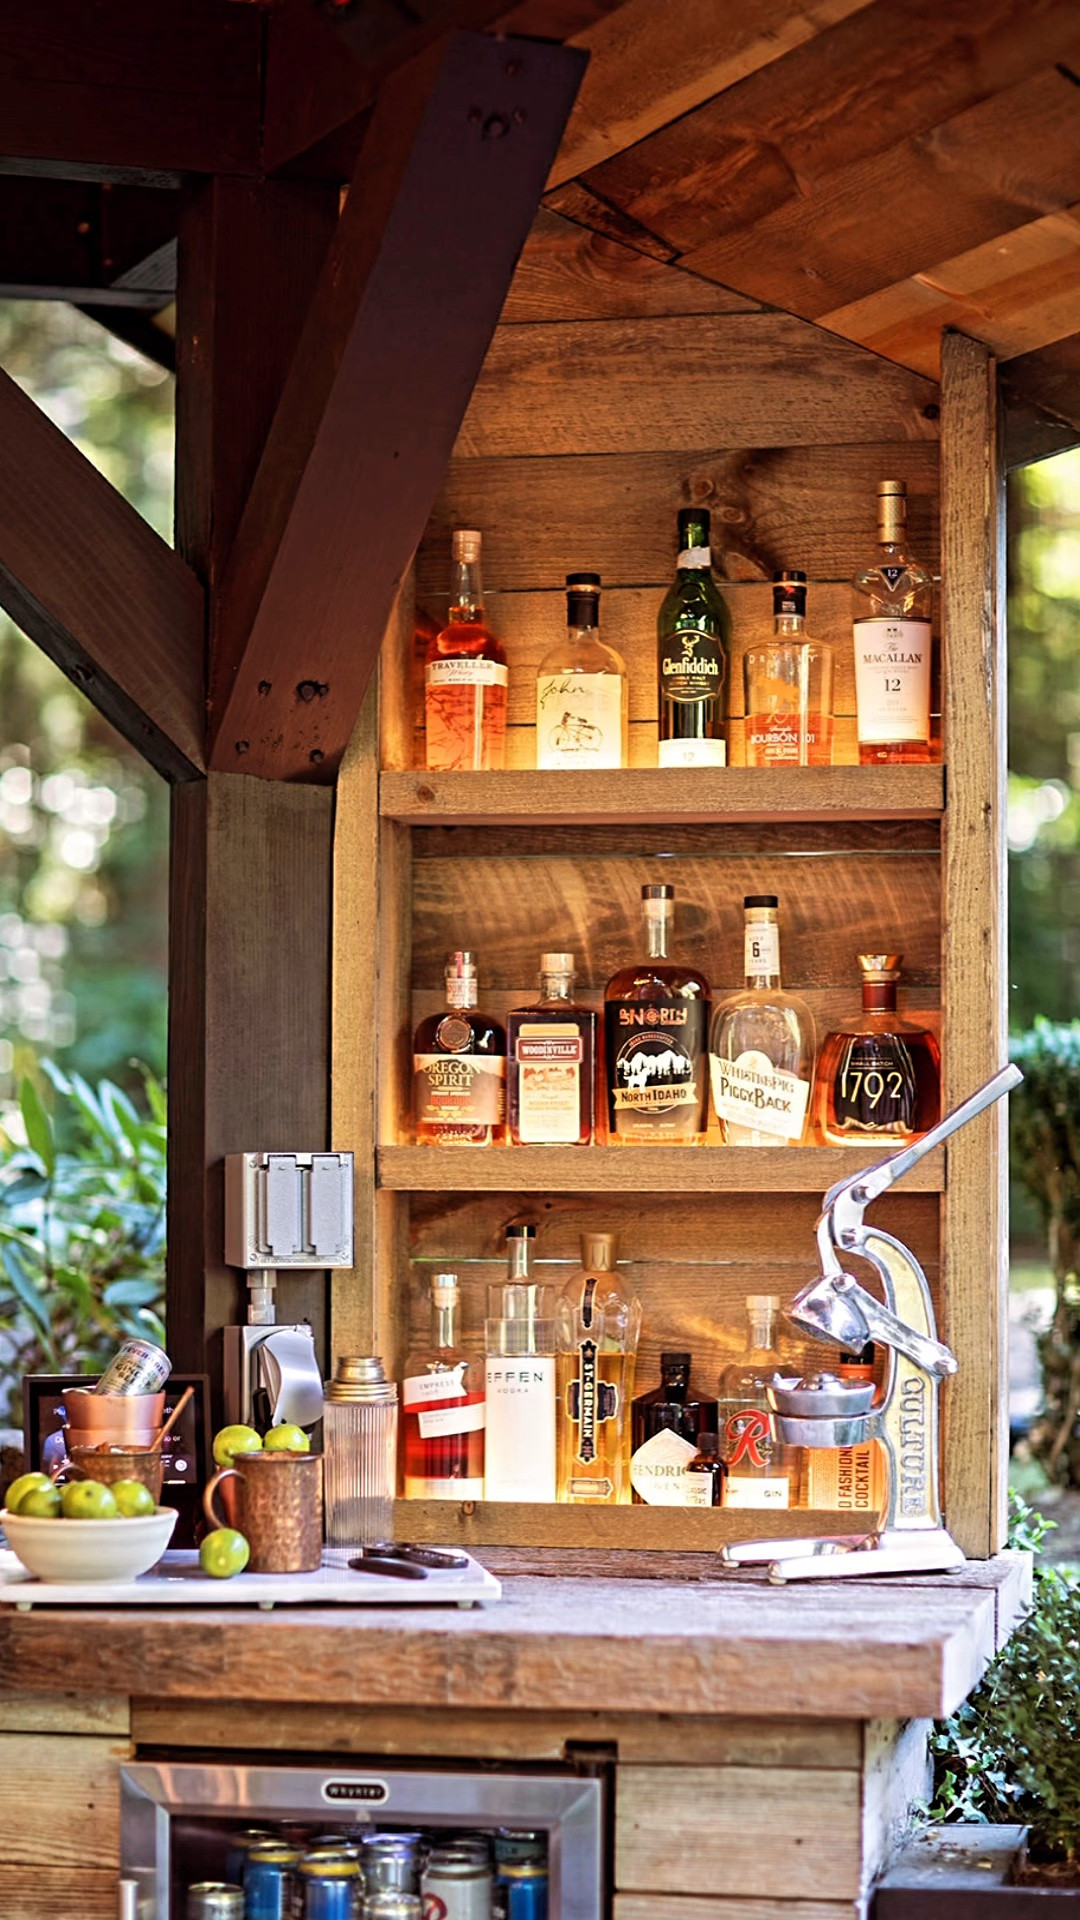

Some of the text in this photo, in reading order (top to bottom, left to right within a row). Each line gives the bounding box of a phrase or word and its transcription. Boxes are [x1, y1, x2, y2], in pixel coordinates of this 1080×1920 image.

[887, 568, 898, 578] 12
[863, 653, 923, 664] MACALLAN
[431, 661, 493, 671] TRAVELLER
[662, 657, 719, 676] Glenfiddich
[885, 678, 901, 692] 12
[750, 732, 798, 745] BOURBON
[752, 941, 760, 958] 6
[521, 1045, 578, 1055] WOODINVILLE
[422, 1060, 481, 1075] OREGON
[428, 1074, 474, 1087] SPIRIT
[621, 1088, 687, 1103] NORTH IDAHO
[842, 1071, 903, 1109] 1792
[487, 1371, 544, 1383] EFFEN
[583, 1363, 594, 1438] ST-GERMAIN
[725, 1408, 771, 1468] R
[855, 1450, 870, 1508] COCKTAIL
[764, 1489, 783, 1499] GIN
[329, 1786, 382, 1798] Whynter
